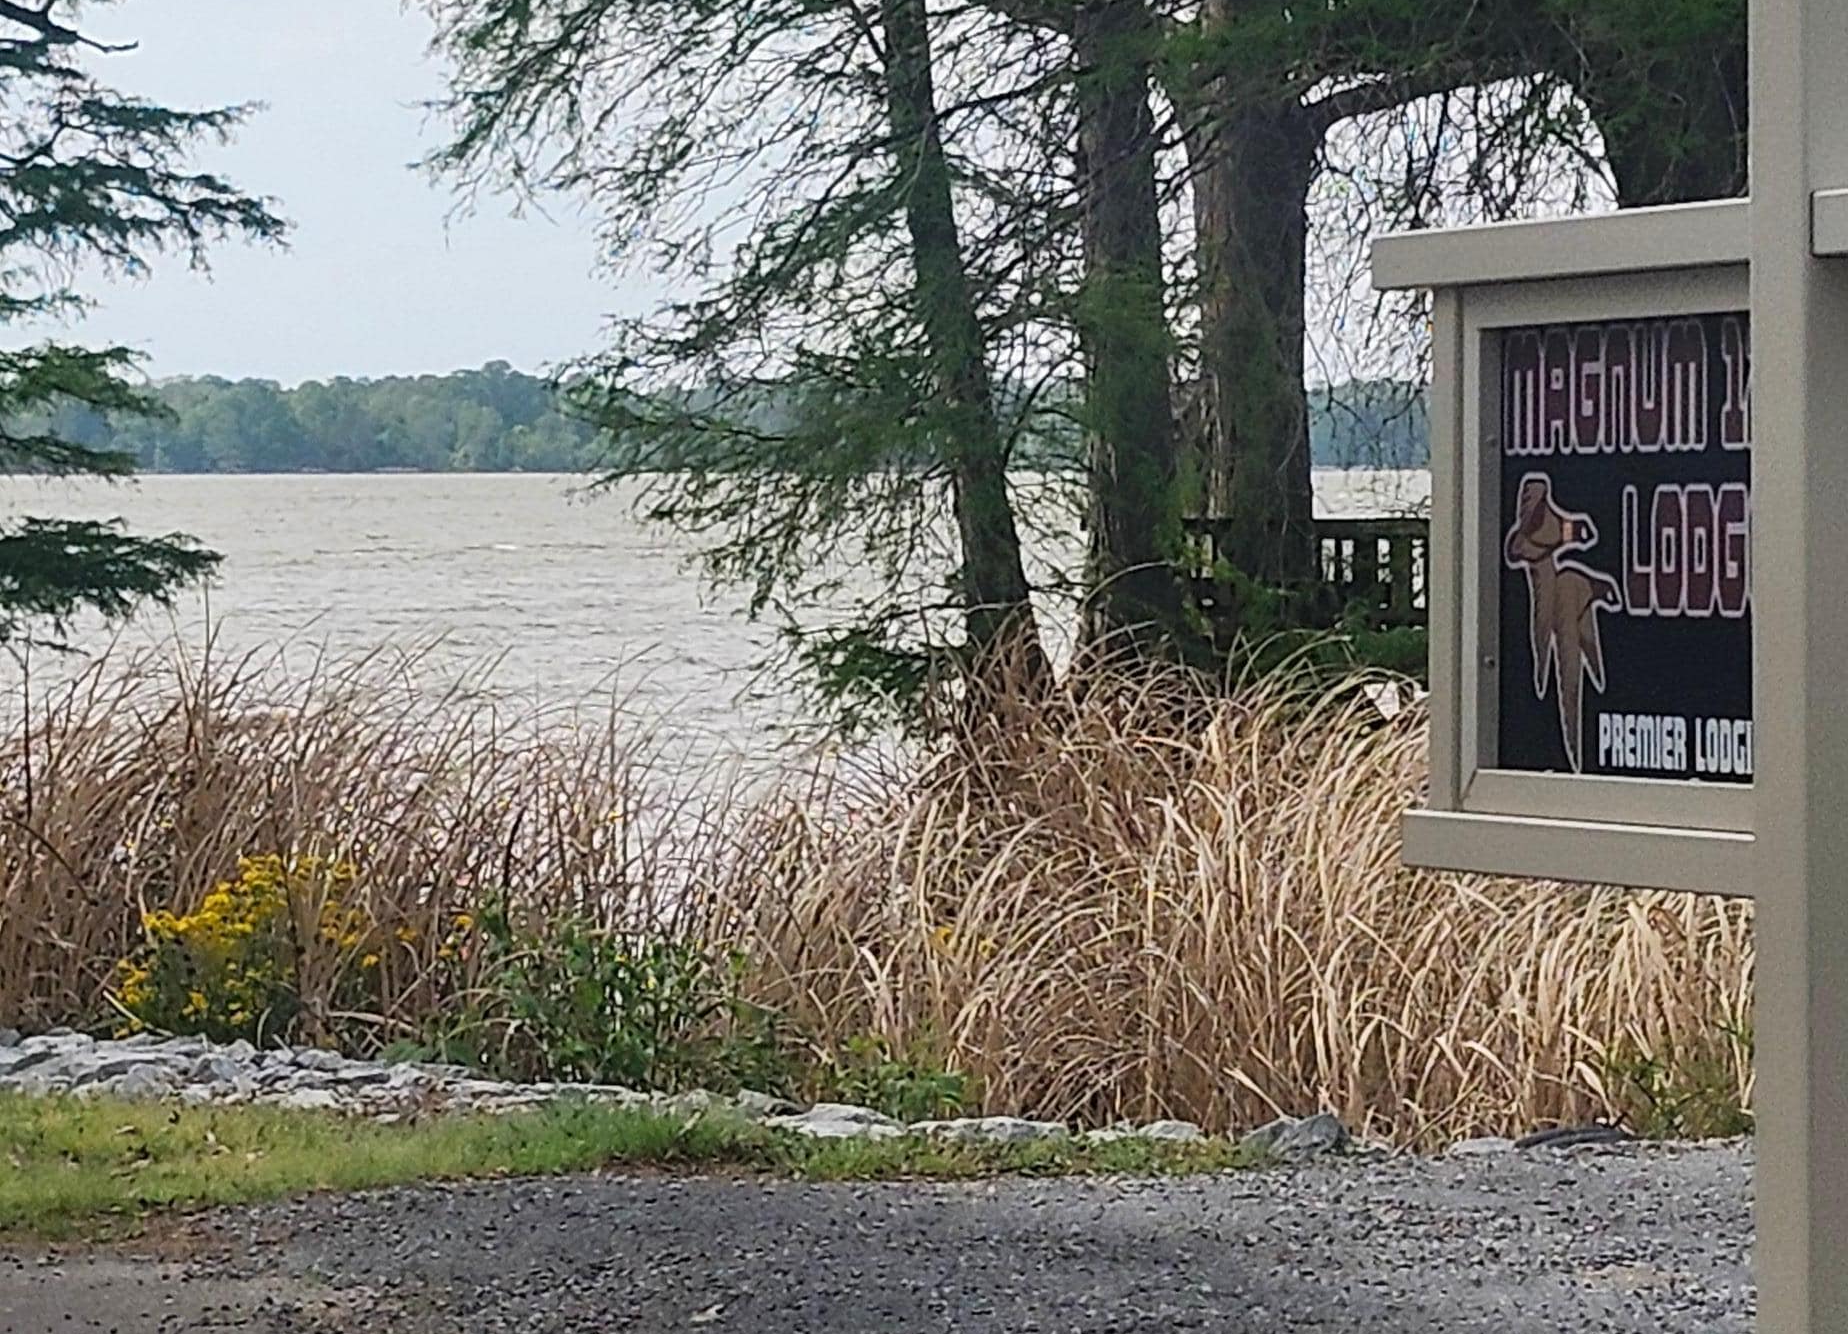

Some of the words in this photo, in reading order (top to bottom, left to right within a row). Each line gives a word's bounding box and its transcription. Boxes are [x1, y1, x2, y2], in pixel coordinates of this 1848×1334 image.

[1504, 318, 1708, 455] MAGNUM
[1721, 317, 1751, 450] 1
[1622, 482, 1751, 618] LODG
[1599, 713, 1687, 771] PREMIER
